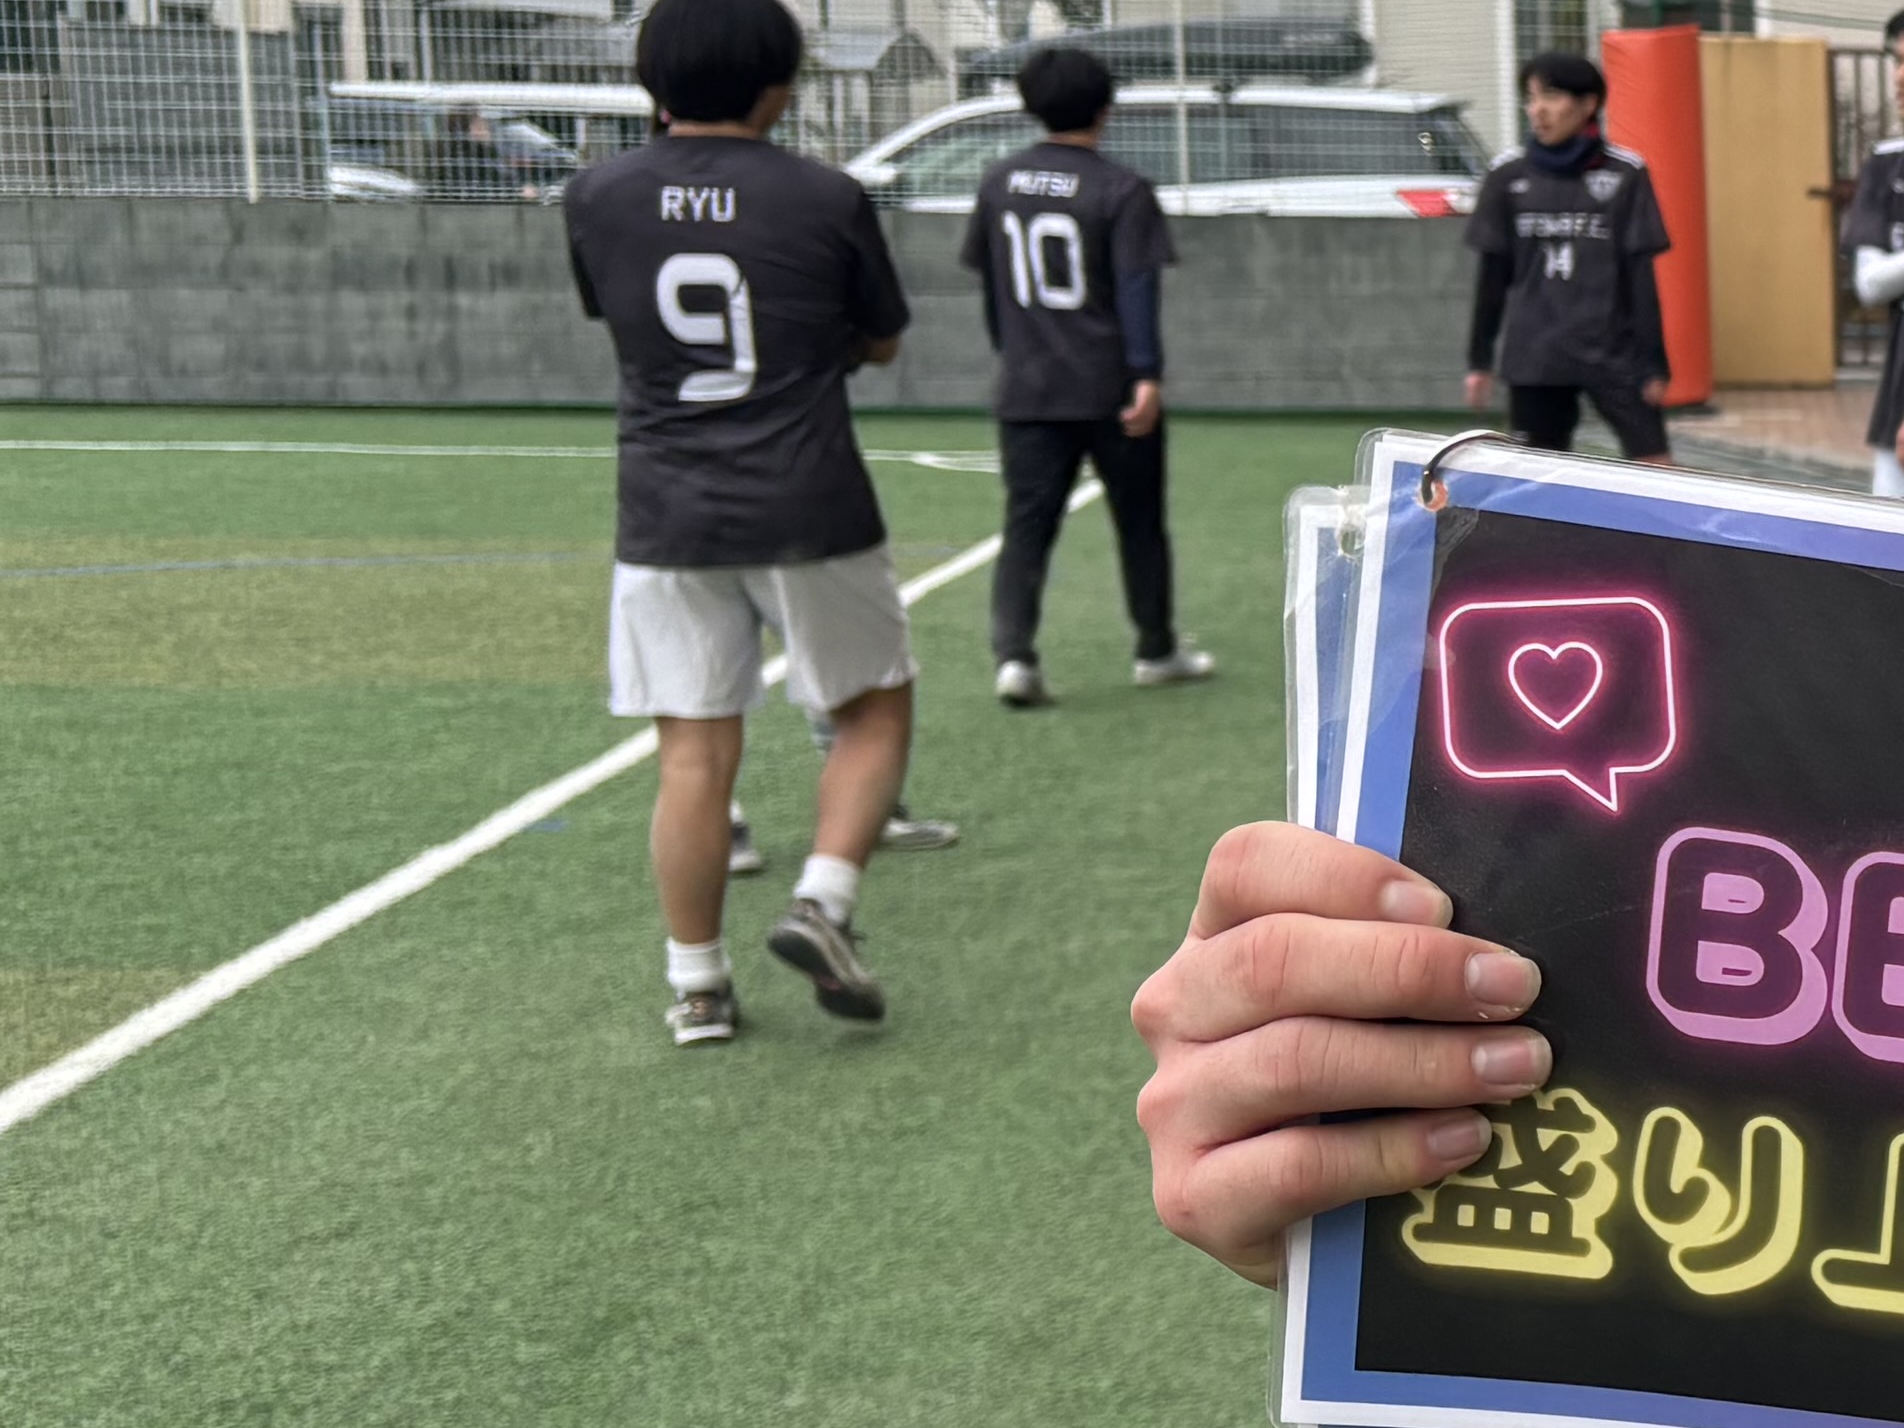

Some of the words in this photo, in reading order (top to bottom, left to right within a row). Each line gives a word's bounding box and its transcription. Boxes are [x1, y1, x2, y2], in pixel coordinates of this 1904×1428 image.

[661, 186, 736, 221] RYU
[1002, 210, 1087, 310] 10
[657, 253, 757, 402] 9
